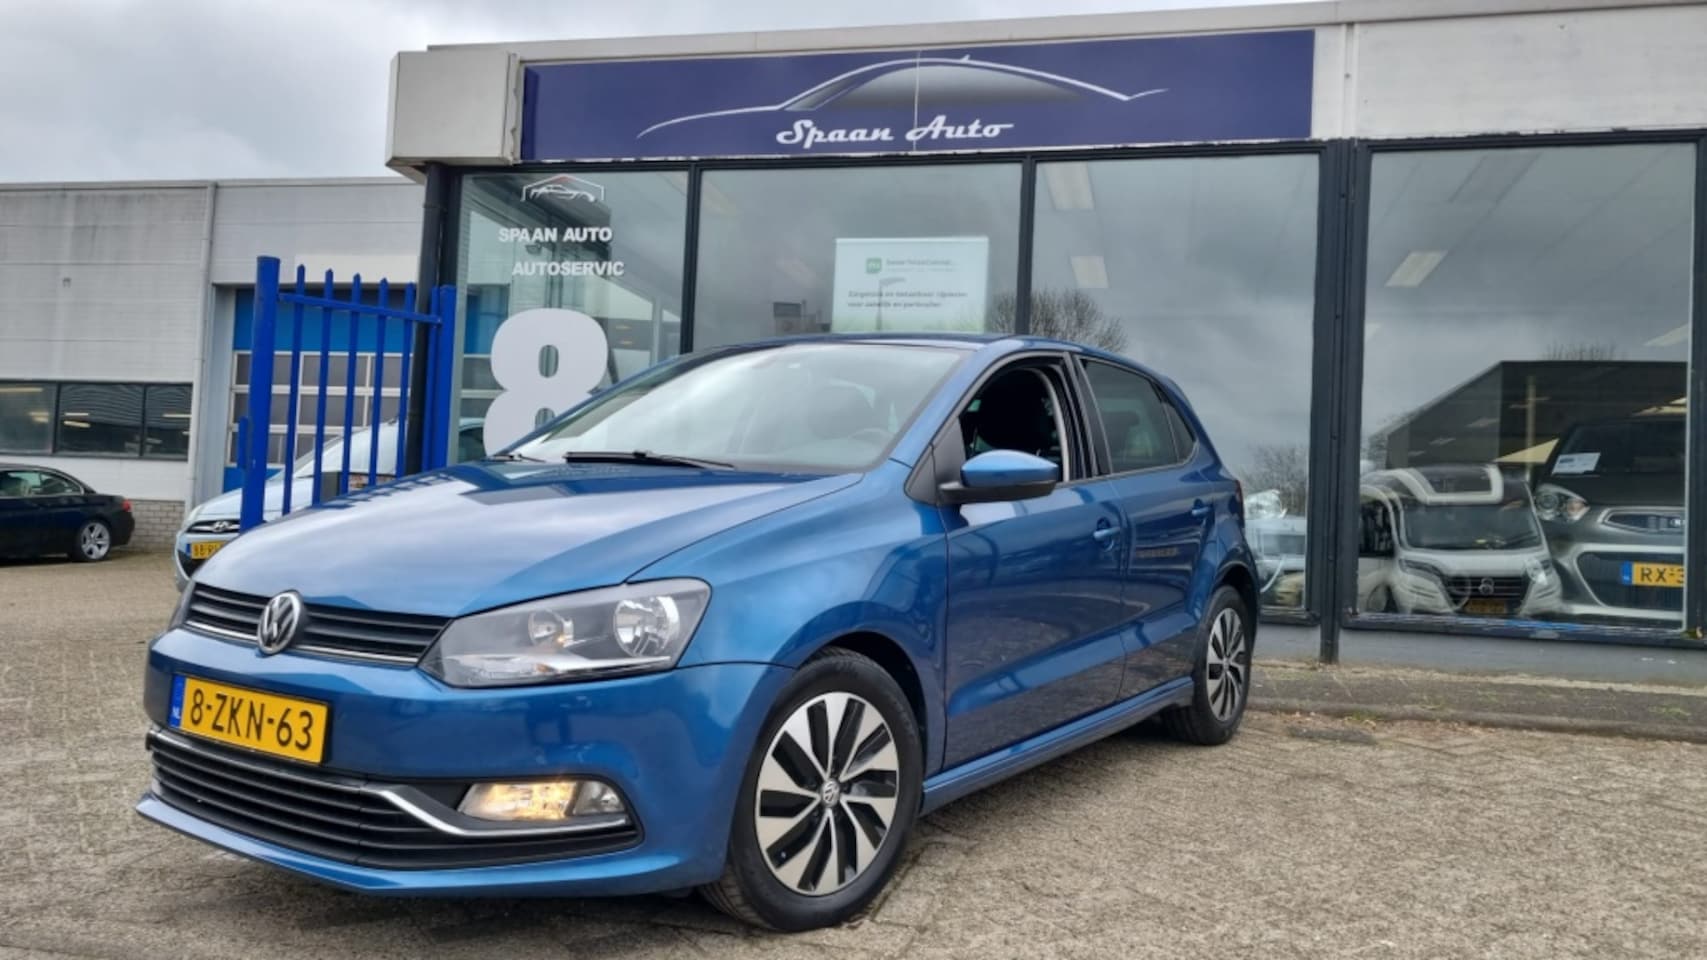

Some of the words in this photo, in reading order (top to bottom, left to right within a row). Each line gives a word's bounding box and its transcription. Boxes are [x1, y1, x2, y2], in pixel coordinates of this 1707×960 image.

[776, 119, 894, 149] Spaan
[905, 115, 1014, 140] Auto
[498, 227, 558, 243] SPAAN
[563, 226, 613, 242] AUTO
[512, 260, 625, 276] AUTOSERVIC
[190, 687, 314, 751] 8-ZKN-63
